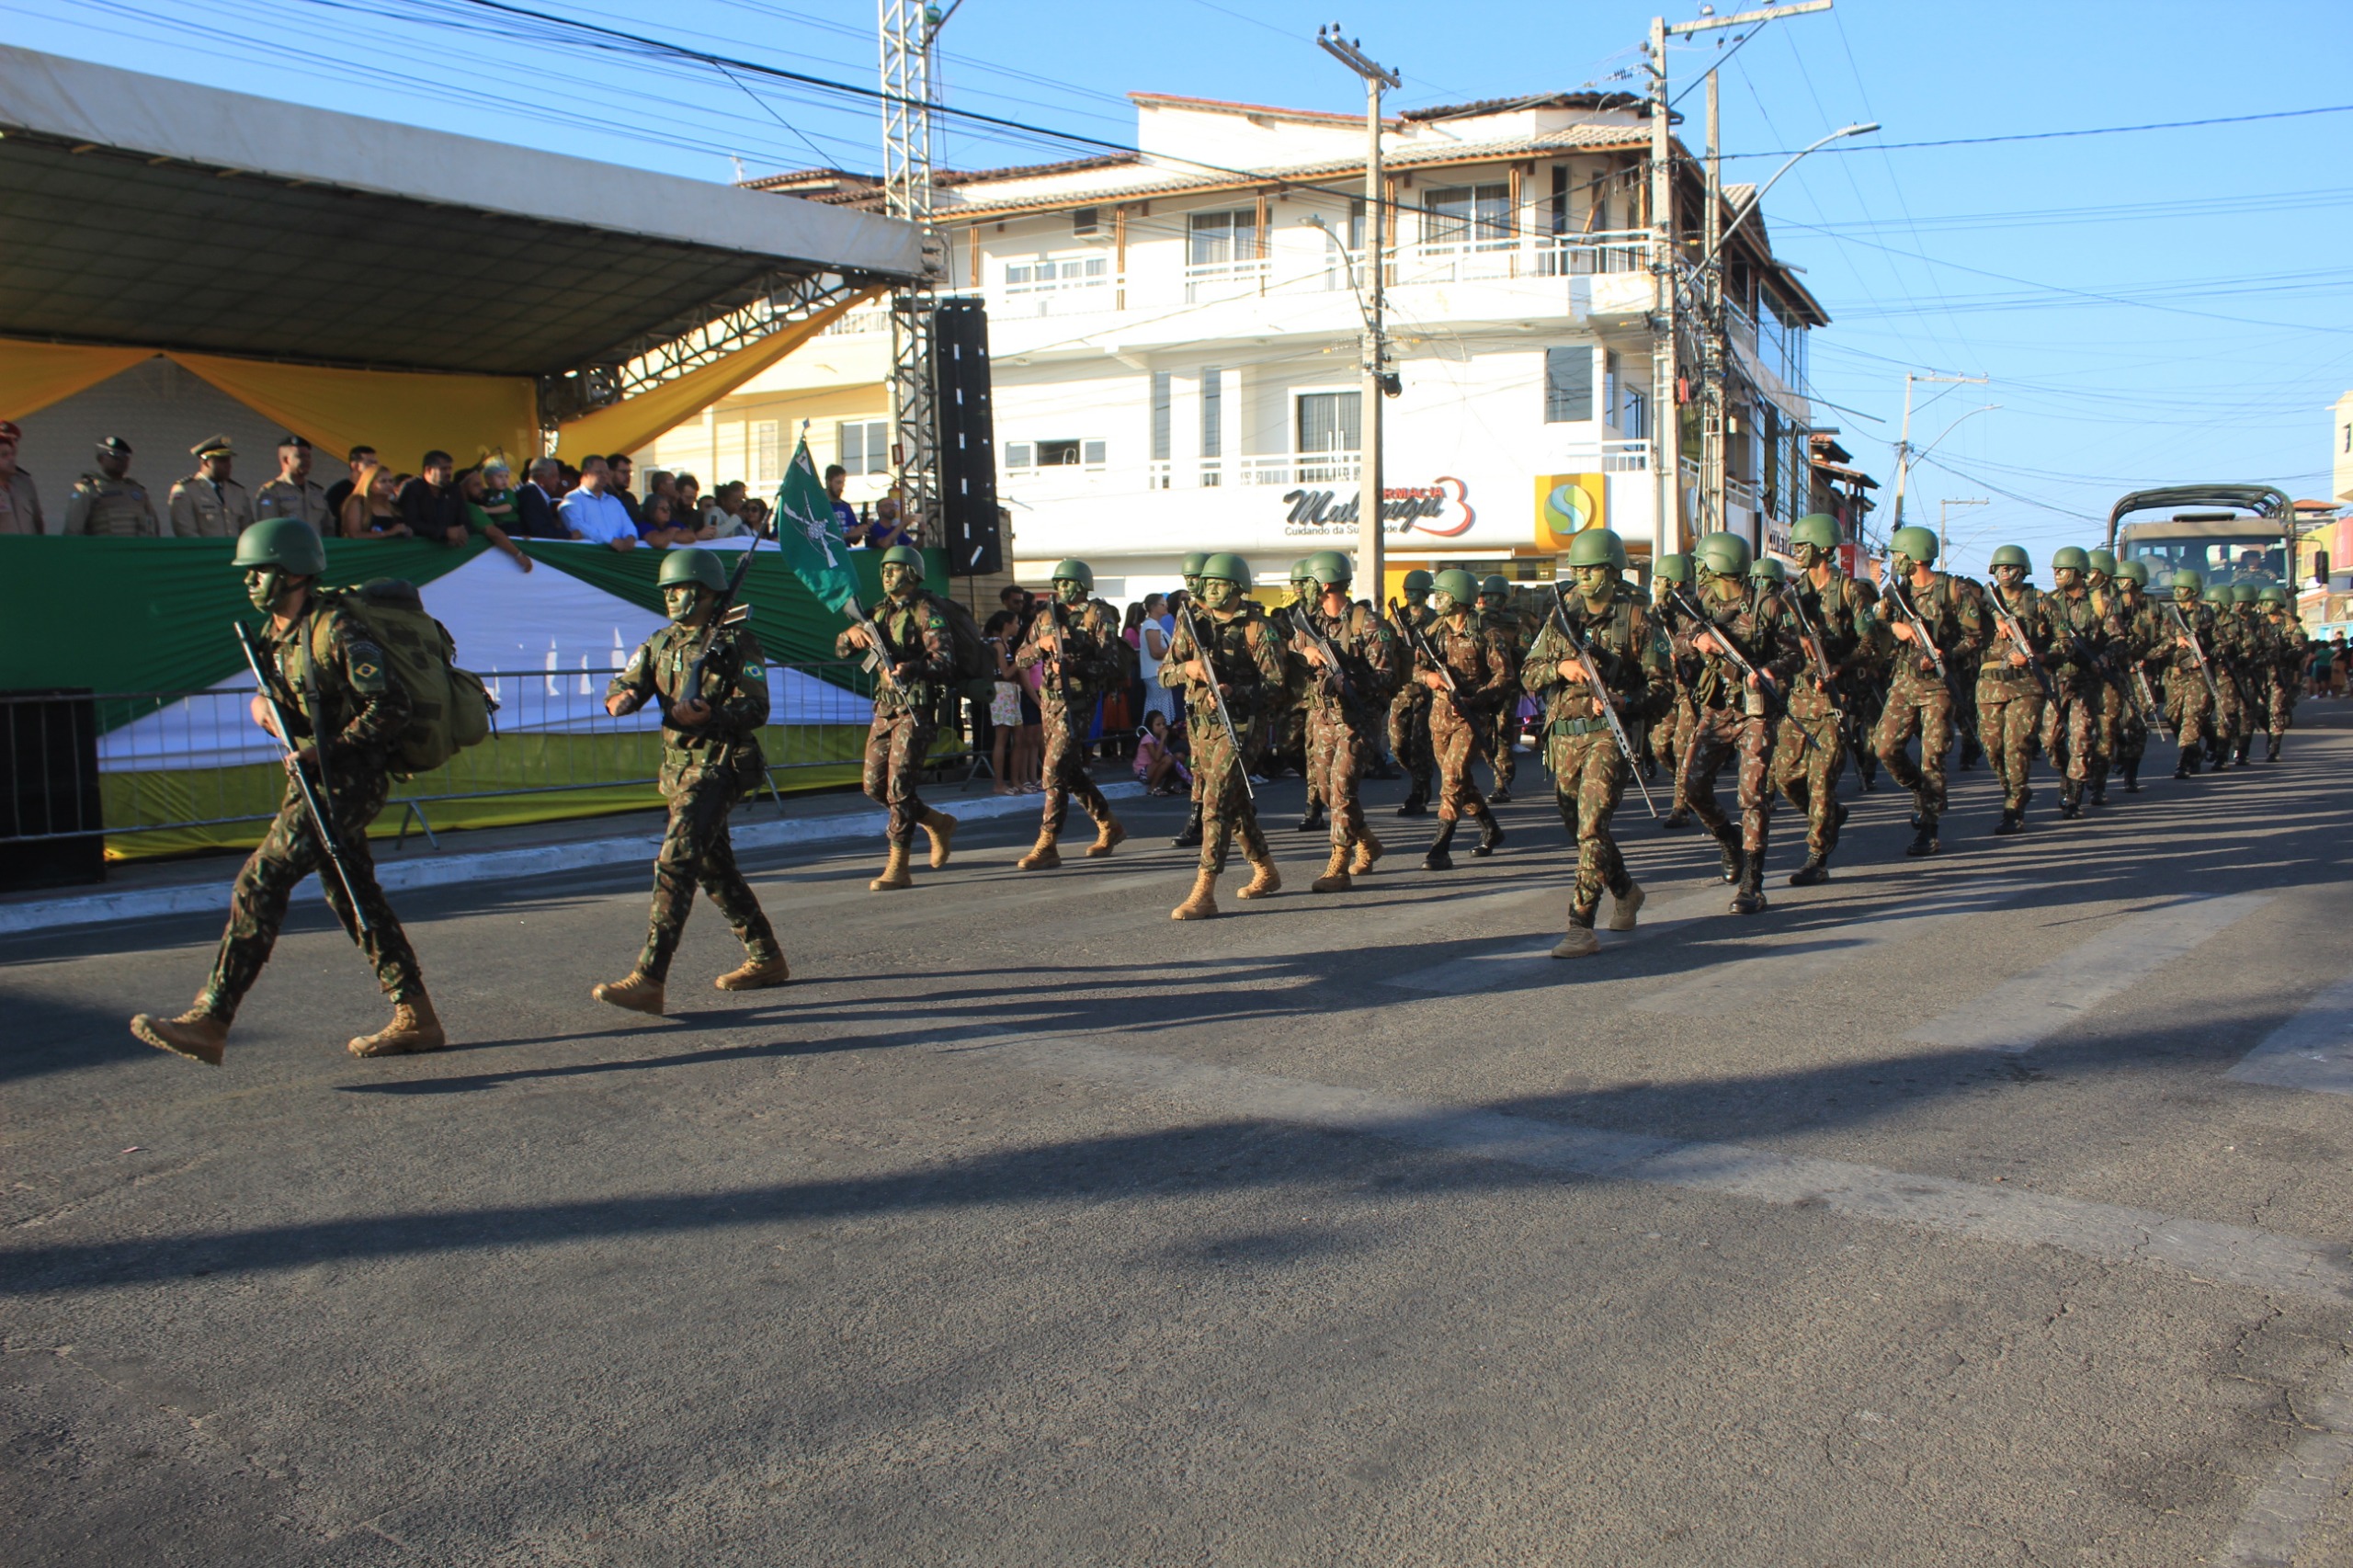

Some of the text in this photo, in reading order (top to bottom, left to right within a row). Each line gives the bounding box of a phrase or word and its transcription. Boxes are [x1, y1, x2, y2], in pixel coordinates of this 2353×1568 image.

[1382, 487, 1446, 500] RMACIA
[1282, 489, 1445, 533] Mulngu
[1285, 525, 1360, 536] Cuidando da Su
